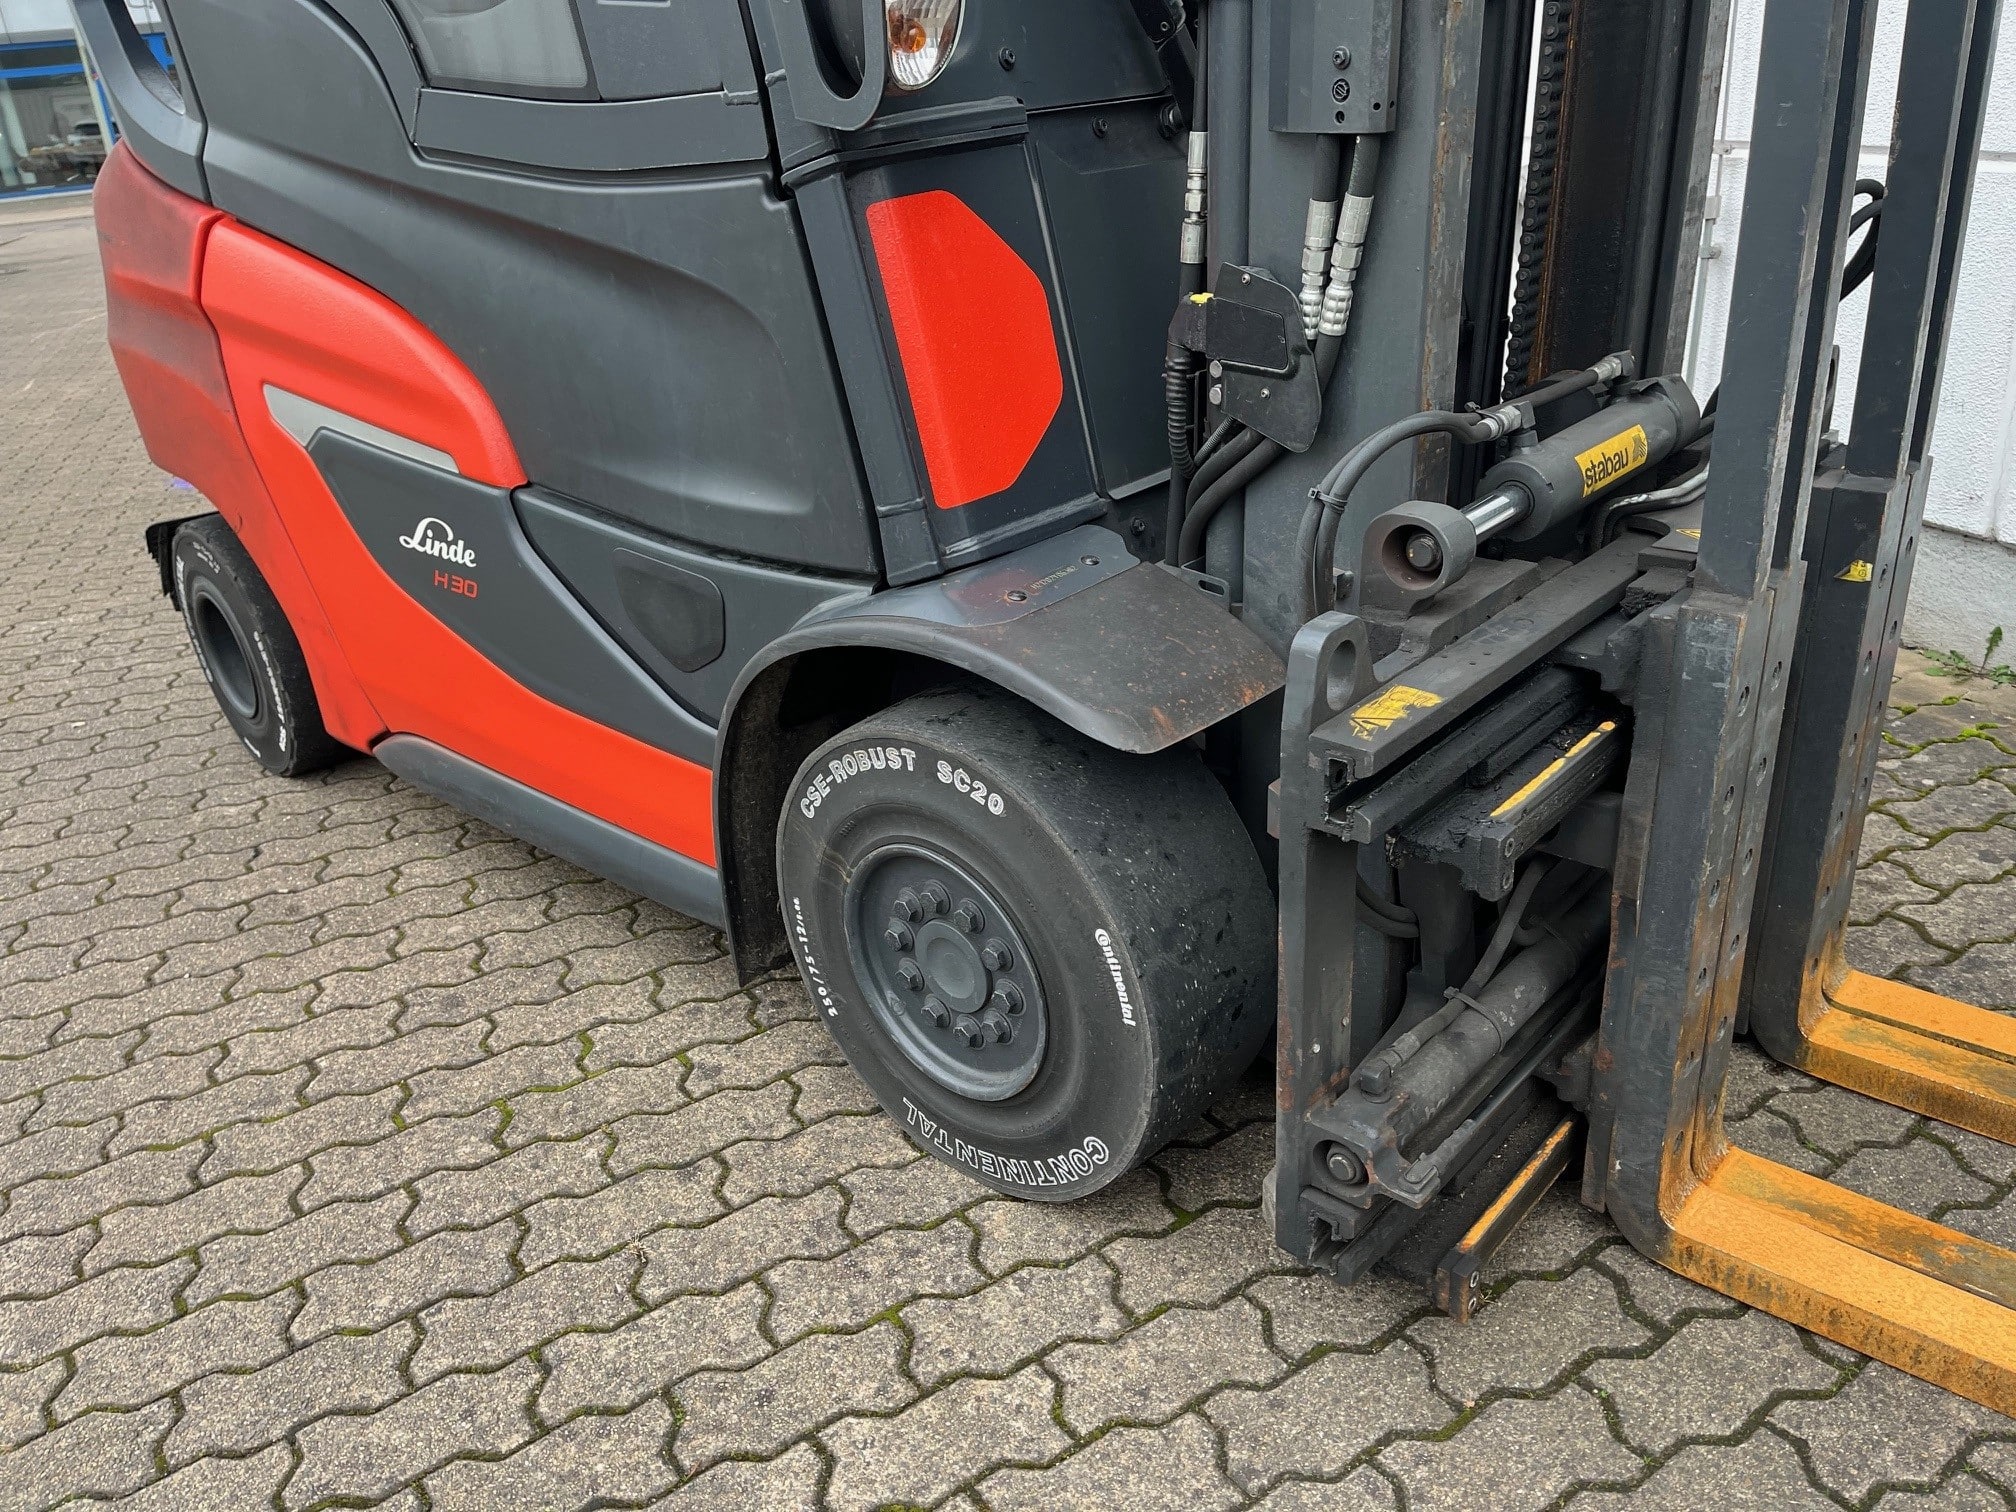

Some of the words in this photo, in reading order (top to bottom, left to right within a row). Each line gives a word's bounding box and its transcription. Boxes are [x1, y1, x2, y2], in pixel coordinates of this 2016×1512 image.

[1584, 447, 1629, 489] stabau
[399, 517, 477, 568] Linde
[800, 746, 917, 820] CSE-ROBUST
[936, 760, 1006, 817] SC20
[902, 1096, 1109, 1187] CONTINENTAL
